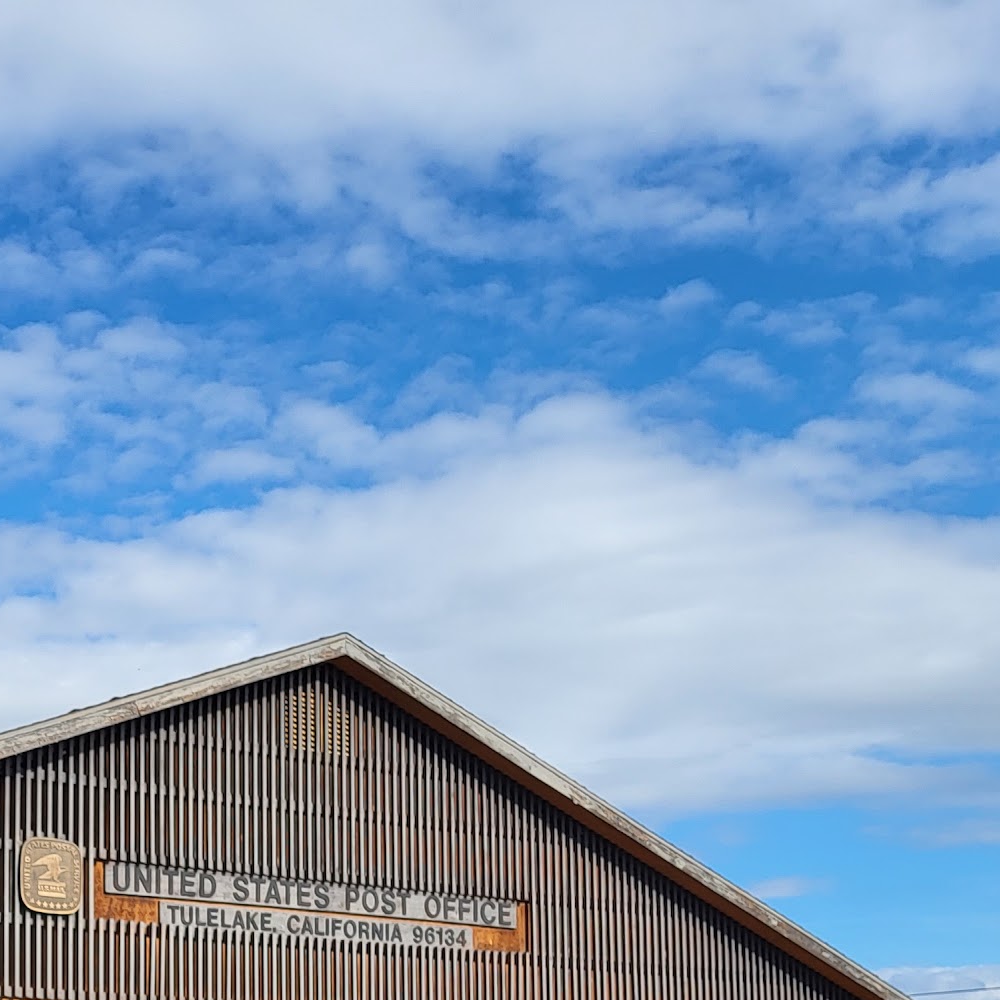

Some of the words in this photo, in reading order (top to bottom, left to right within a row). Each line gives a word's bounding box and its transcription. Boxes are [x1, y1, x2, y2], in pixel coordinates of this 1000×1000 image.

[113, 864, 216, 898] UNITED
[232, 876, 330, 909] STATES
[345, 886, 411, 916] POST
[424, 894, 511, 927] OFFICE
[286, 914, 403, 943] CALIFORNIA
[412, 925, 467, 948] 96134
